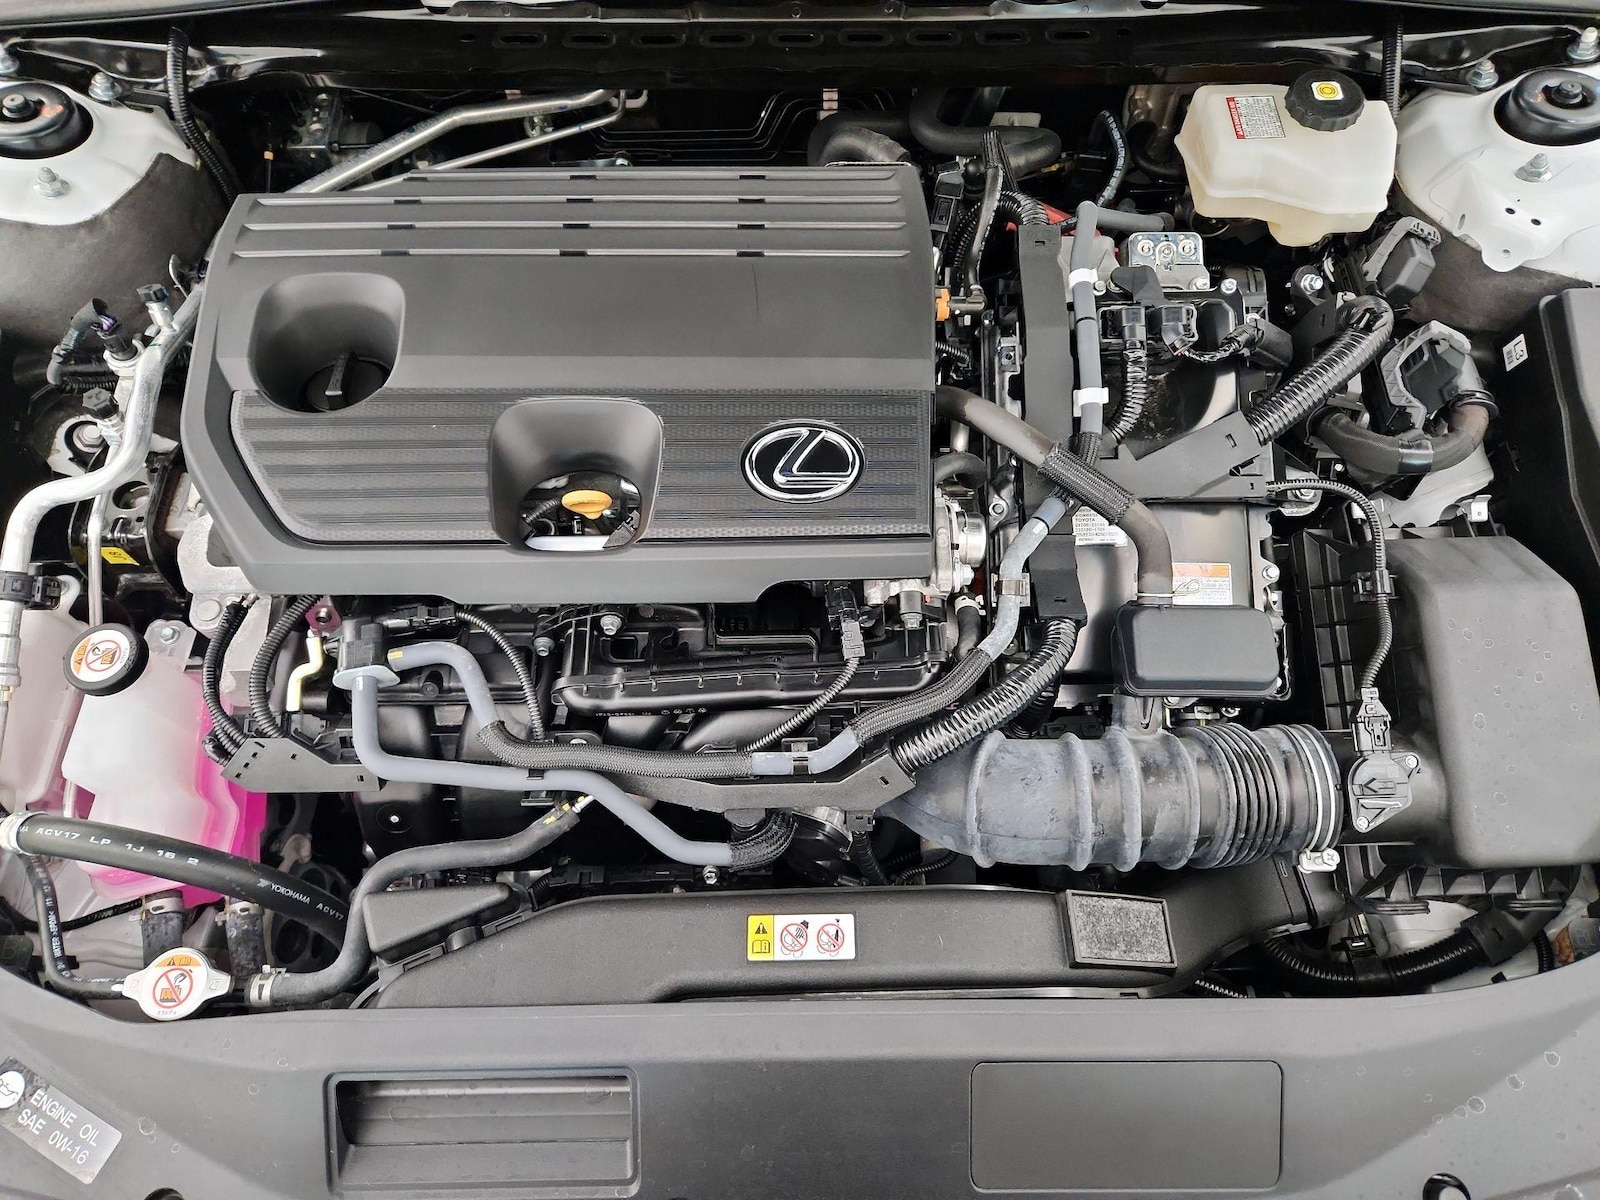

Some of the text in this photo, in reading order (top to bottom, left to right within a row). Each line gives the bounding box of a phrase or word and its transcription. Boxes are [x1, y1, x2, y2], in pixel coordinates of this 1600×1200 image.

[35, 827, 81, 840] ACV17
[89, 835, 112, 846] LP
[271, 883, 344, 920] YOKOHAMA ACV17
[51, 936, 63, 958] WATER
[29, 1088, 100, 1147] ENGINE OIL
[17, 1108, 90, 1165] SAE 0W-16
